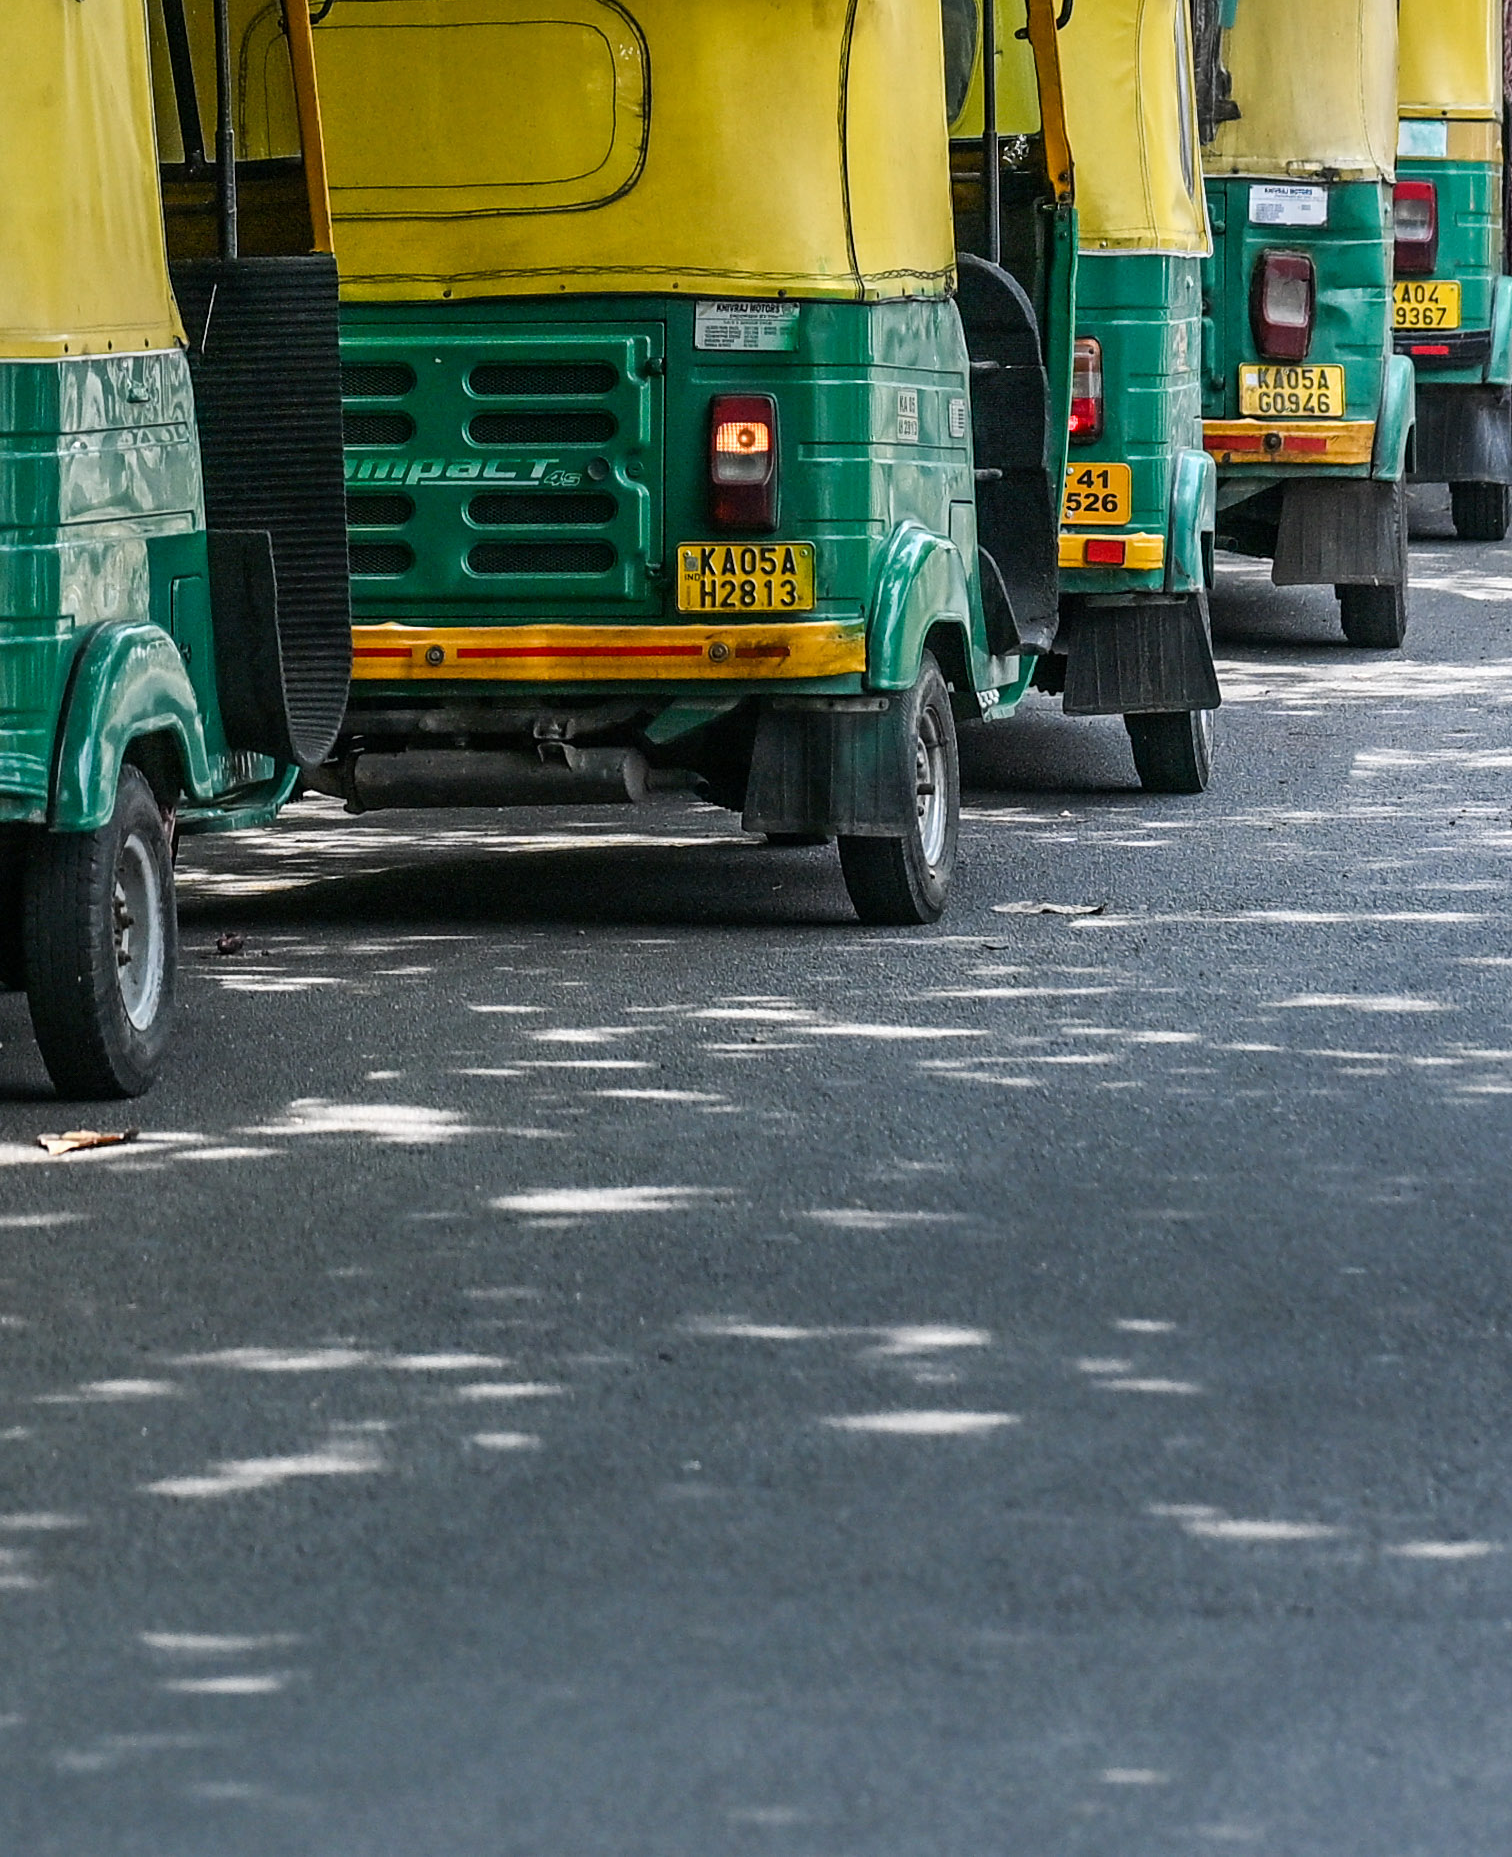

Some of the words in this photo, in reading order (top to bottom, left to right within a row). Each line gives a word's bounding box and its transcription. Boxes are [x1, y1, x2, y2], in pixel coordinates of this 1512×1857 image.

[749, 303, 780, 314] MOTORS
[1395, 306, 1447, 326] 9367
[1257, 367, 1330, 390] KA05A
[1258, 391, 1331, 414] G0946
[1076, 469, 1109, 489] 41
[1065, 492, 1119, 513] 526
[700, 546, 798, 576] KA05A
[700, 578, 797, 609] H2813
